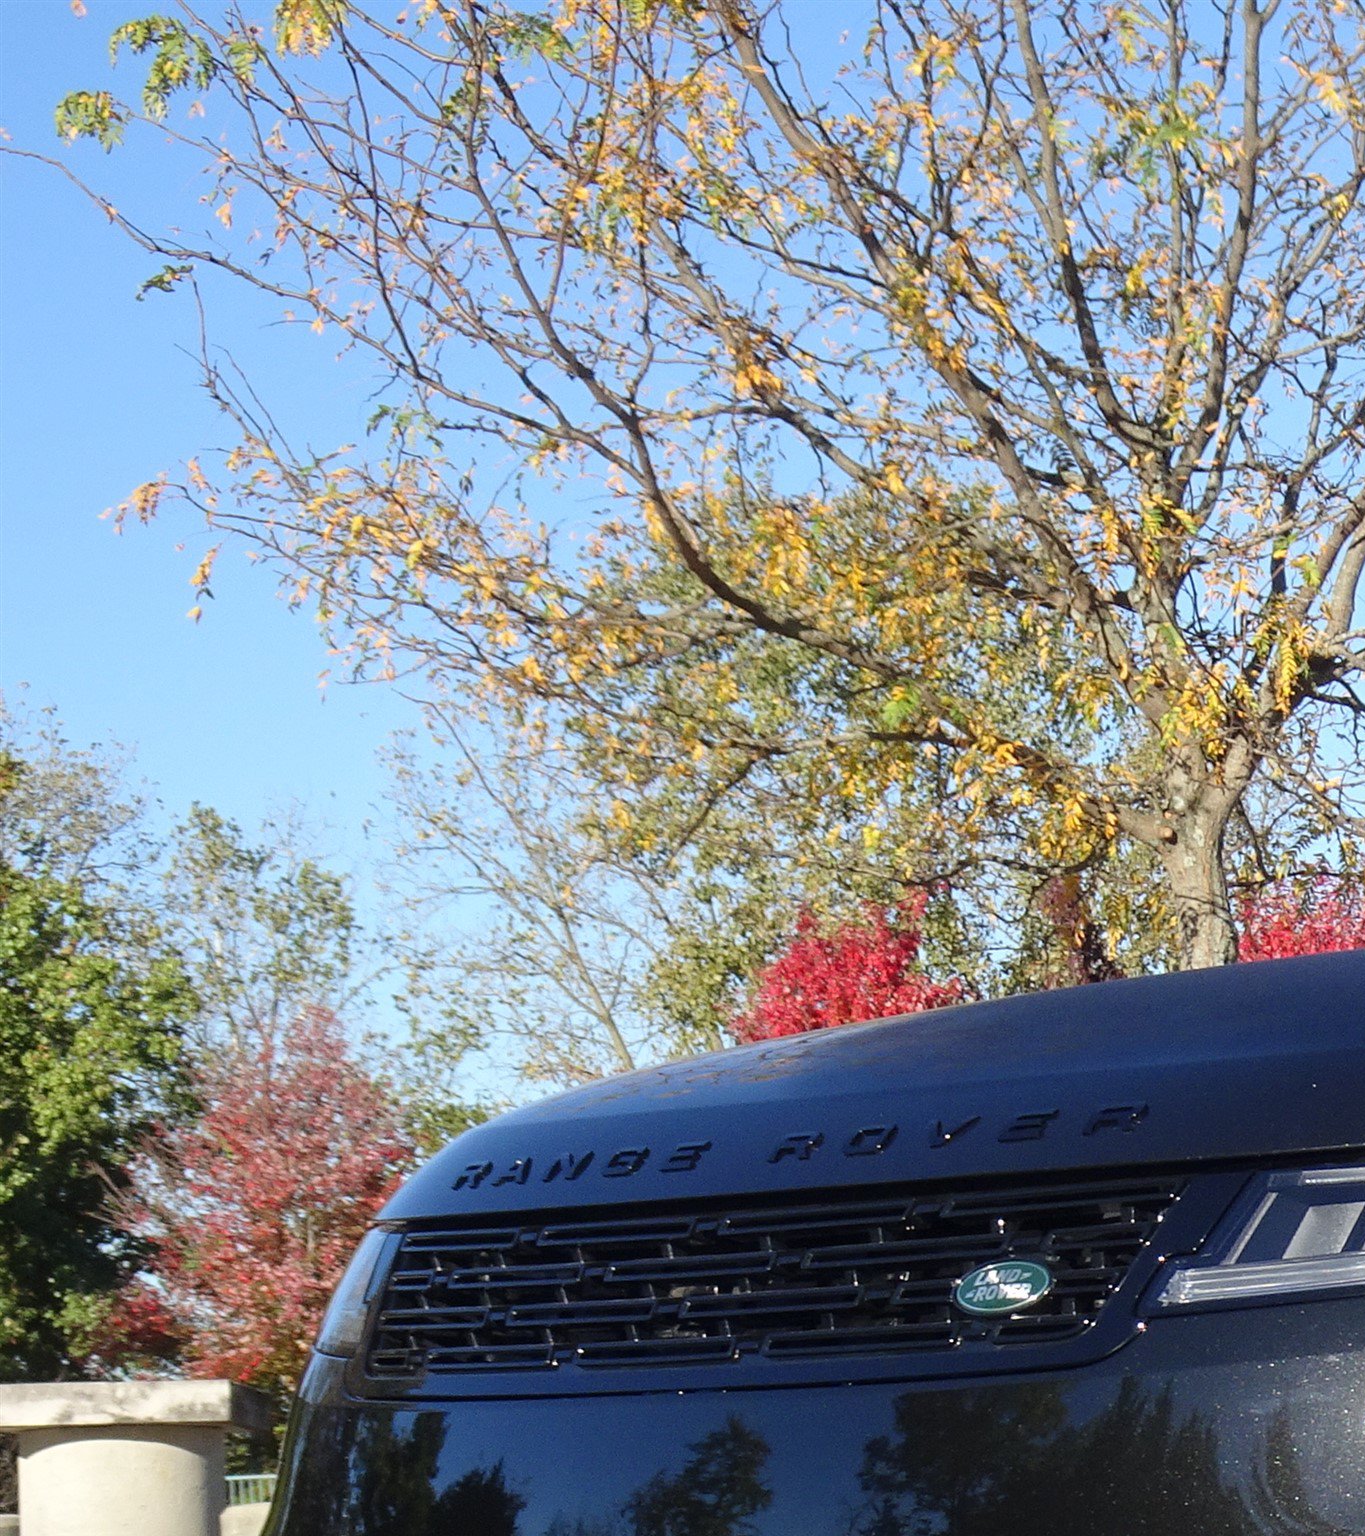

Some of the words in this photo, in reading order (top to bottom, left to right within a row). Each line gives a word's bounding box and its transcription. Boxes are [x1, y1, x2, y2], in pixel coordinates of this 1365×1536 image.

[451, 1140, 713, 1192] RANGE
[767, 1101, 1150, 1166] ROVER
[973, 1268, 1023, 1287] LAND
[972, 1282, 1033, 1303] ROVER
